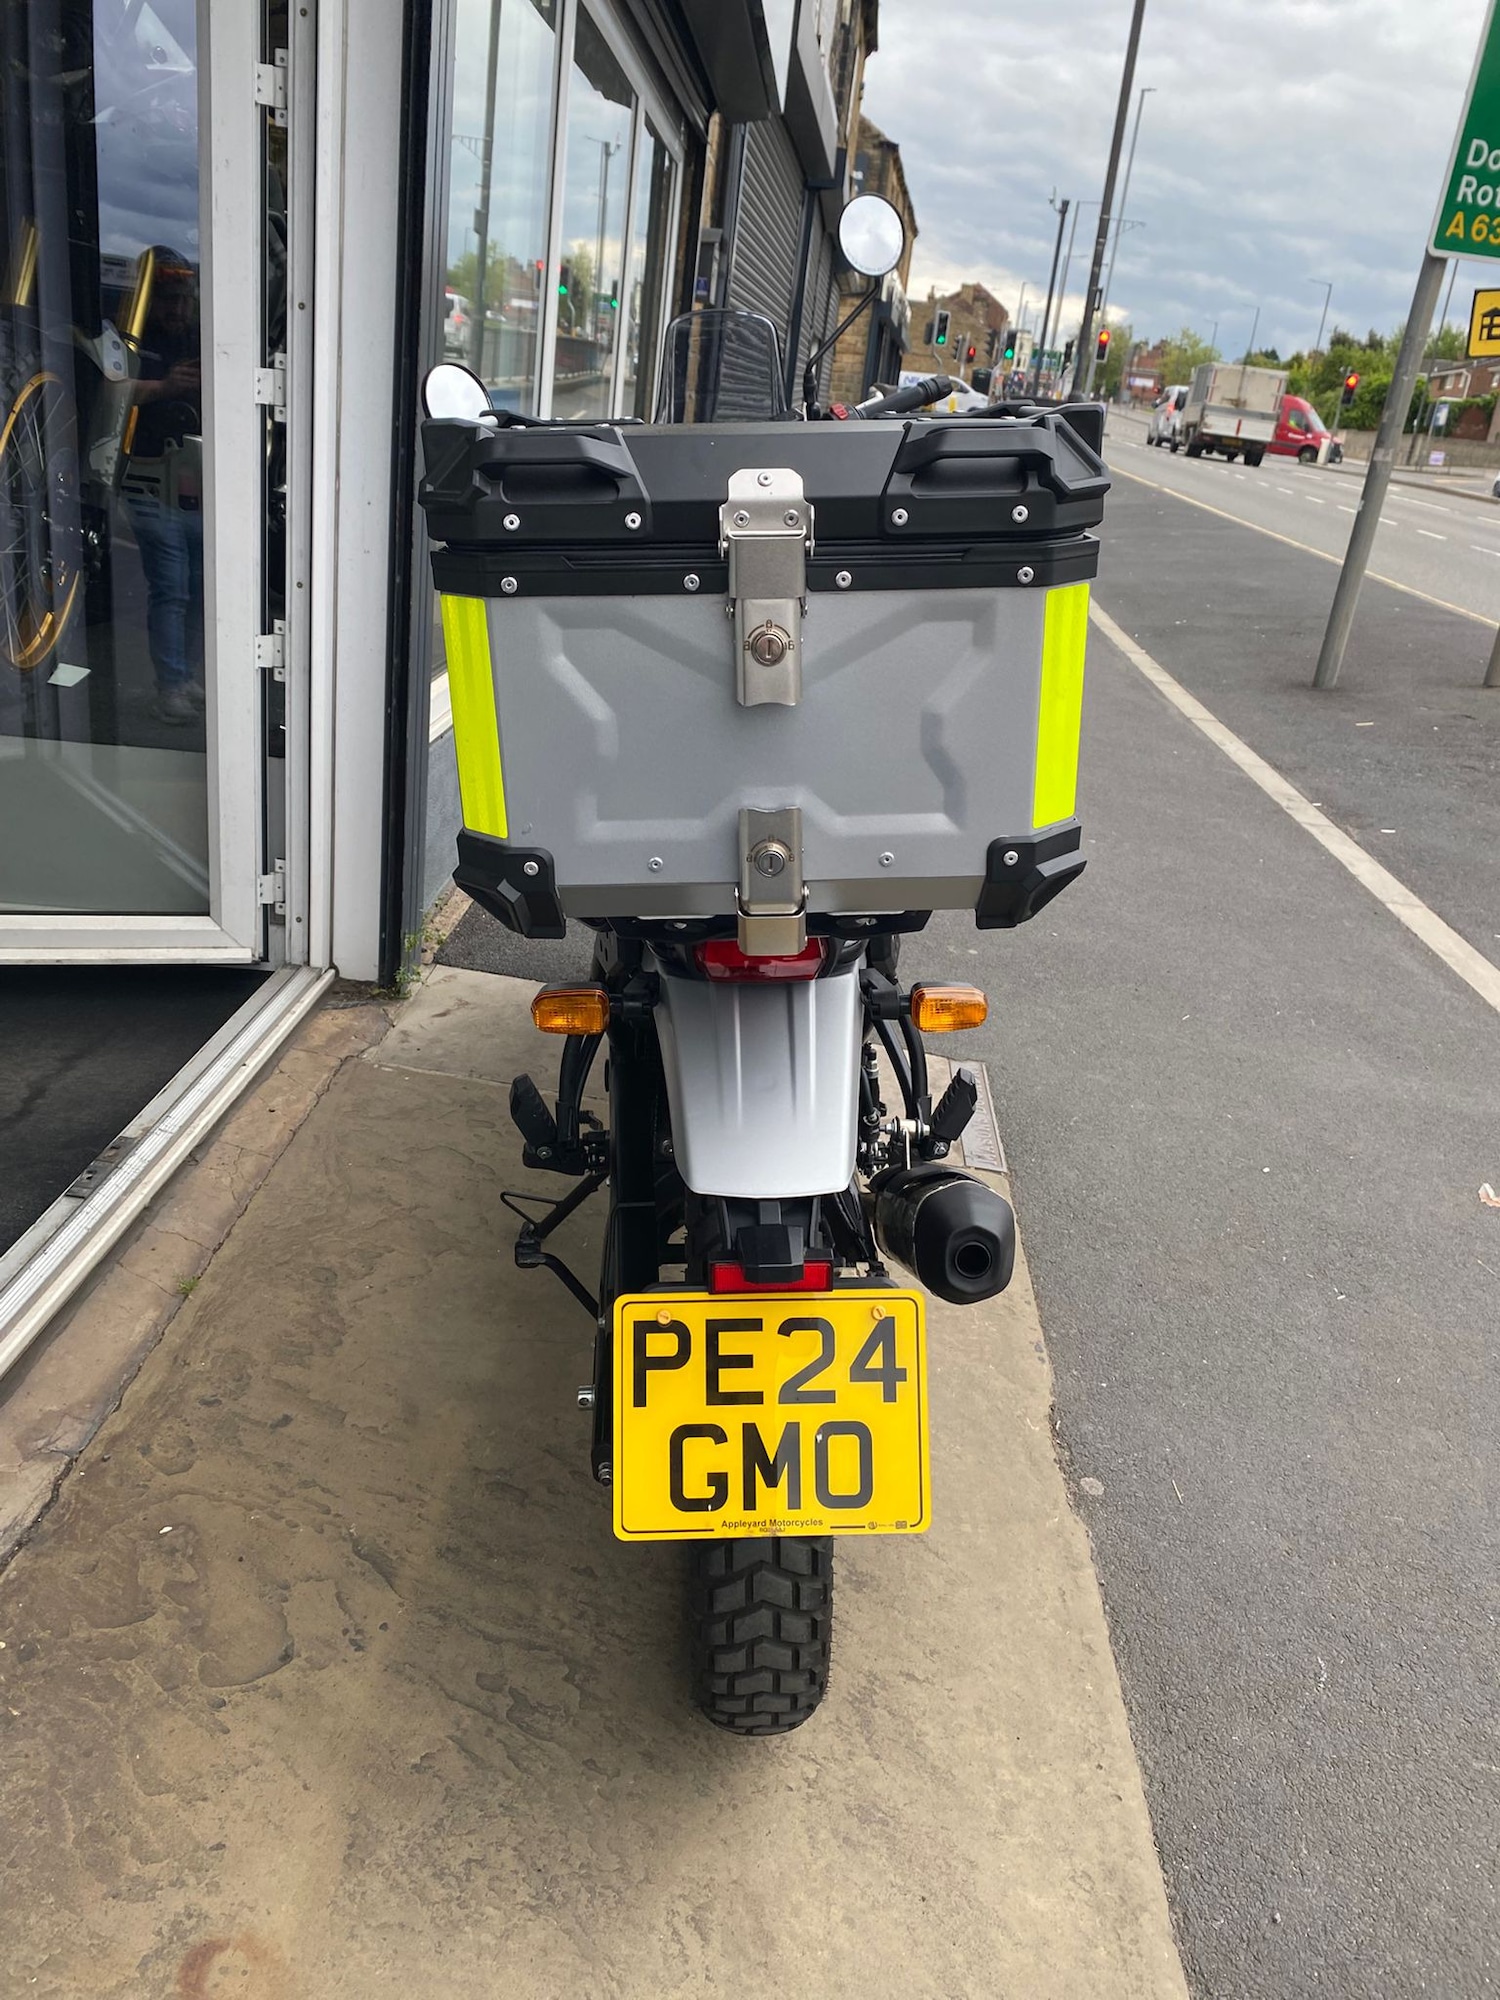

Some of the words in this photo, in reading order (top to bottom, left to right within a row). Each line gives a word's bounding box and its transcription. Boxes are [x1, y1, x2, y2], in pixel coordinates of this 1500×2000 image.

[632, 1316, 908, 1408] PE24
[668, 1420, 875, 1513] GMO
[721, 1519, 767, 1530] Appleyard
[769, 1518, 824, 1528] Motorcycles
